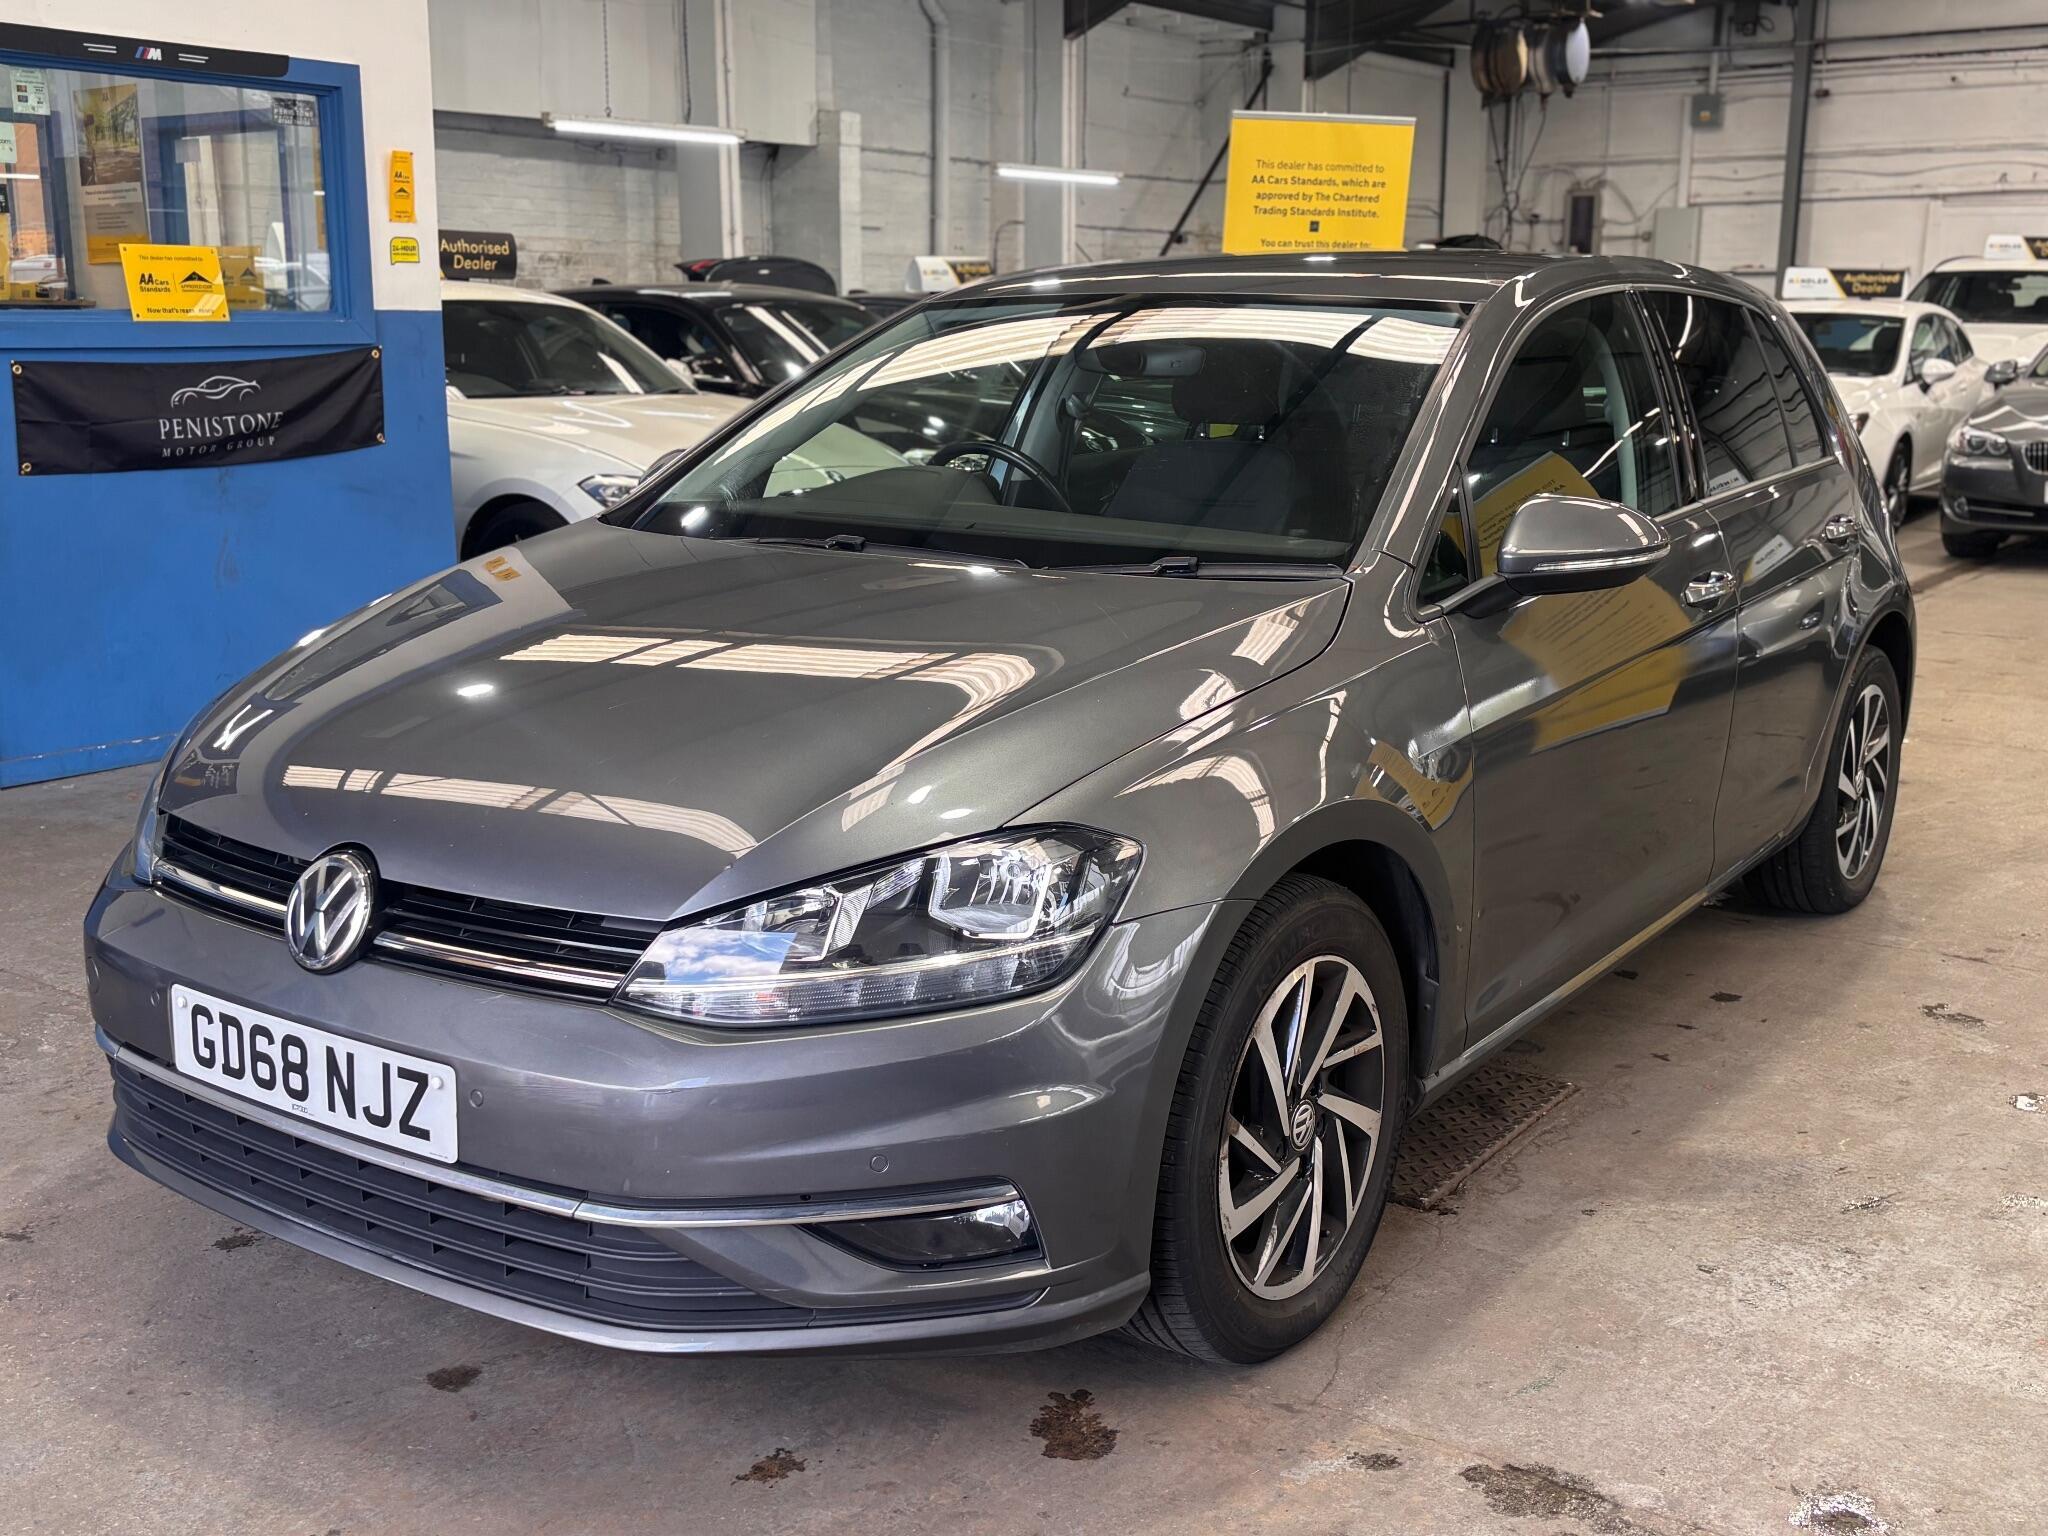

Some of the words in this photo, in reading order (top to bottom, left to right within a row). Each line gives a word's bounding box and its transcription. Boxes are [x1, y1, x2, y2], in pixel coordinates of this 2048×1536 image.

[1256, 159, 1275, 169] This
[1277, 160, 1306, 170] dealer
[1307, 161, 1324, 171] has
[1325, 162, 1374, 173] committed
[1375, 164, 1385, 173] to
[1251, 175, 1266, 184] AA
[1267, 176, 1289, 185] Cars
[1290, 177, 1339, 187] Standards,
[1341, 178, 1370, 188] which
[1256, 191, 1300, 202] approved
[1301, 192, 1313, 202] by
[1315, 193, 1331, 202] The
[1332, 194, 1380, 203] Chartered
[1253, 205, 1288, 217] Trading
[1290, 206, 1336, 217] Standards
[1337, 207, 1380, 219] Institute.
[440, 238, 511, 256] Authorised
[1260, 238, 1276, 248] You
[1277, 240, 1292, 248] can
[1294, 239, 1315, 248] trust
[1315, 239, 1330, 248] this
[1332, 239, 1358, 248] dealer
[453, 255, 498, 271] Dealer
[139, 273, 154, 285] AA
[1843, 272, 1901, 284] Authorised
[1852, 283, 1888, 294] Dealer
[159, 411, 284, 440] PENISTONE
[161, 444, 217, 458] MOTOR
[226, 436, 277, 450] GROUP
[191, 1003, 310, 1102] GD68
[325, 1045, 432, 1142] NJZ
